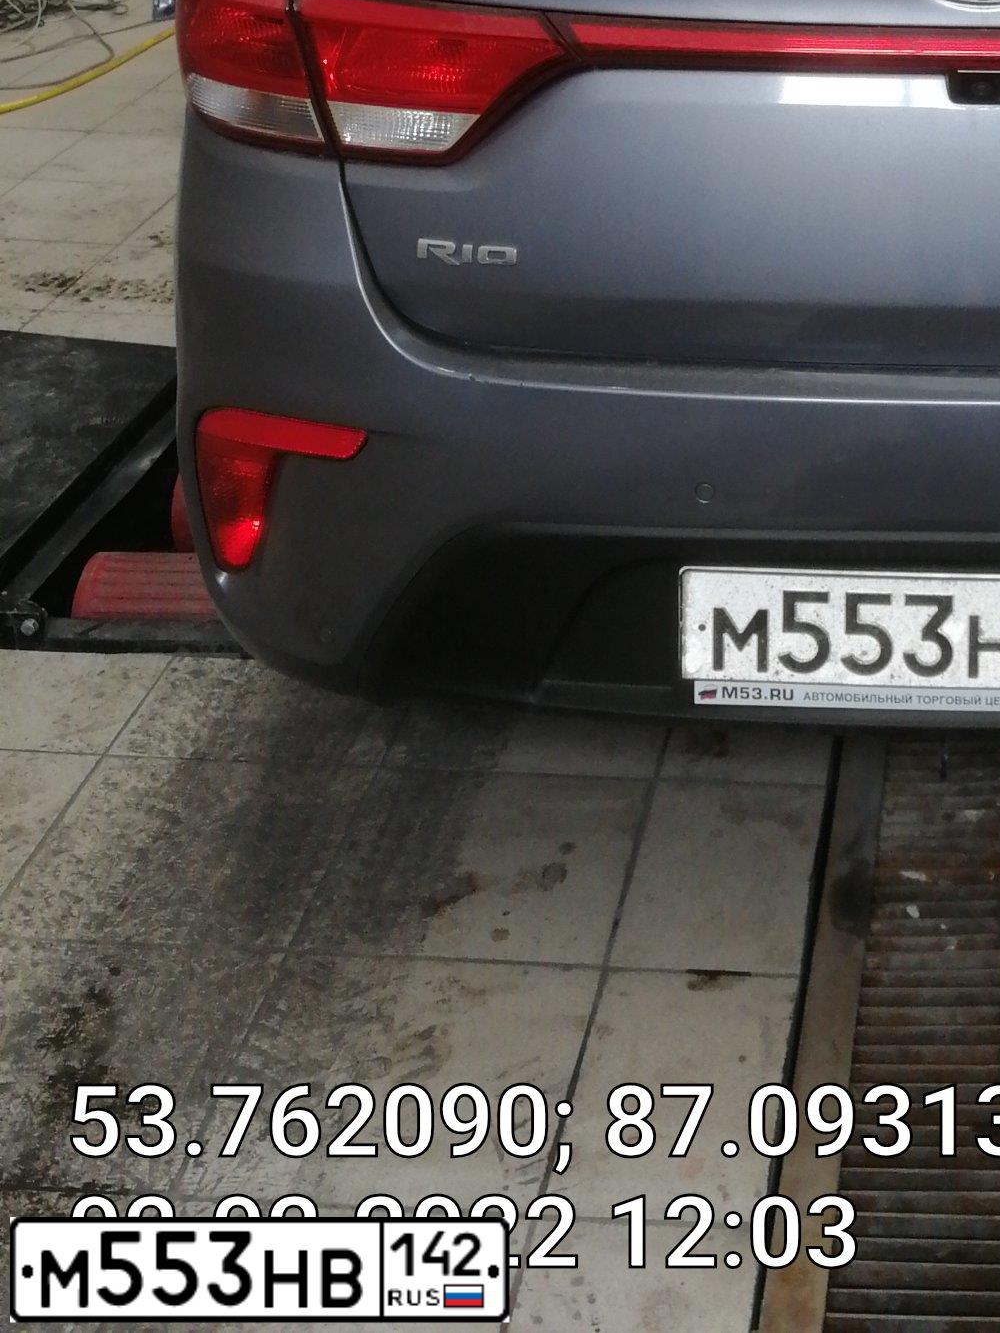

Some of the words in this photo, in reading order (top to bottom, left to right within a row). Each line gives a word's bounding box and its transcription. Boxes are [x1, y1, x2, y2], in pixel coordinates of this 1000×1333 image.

[416, 238, 518, 266] RIO
[721, 686, 795, 702] M53.RU
[802, 691, 913, 705] АВТОМОБИЛЬНЫЙ
[916, 693, 982, 706] ТОРГОВЫЙ
